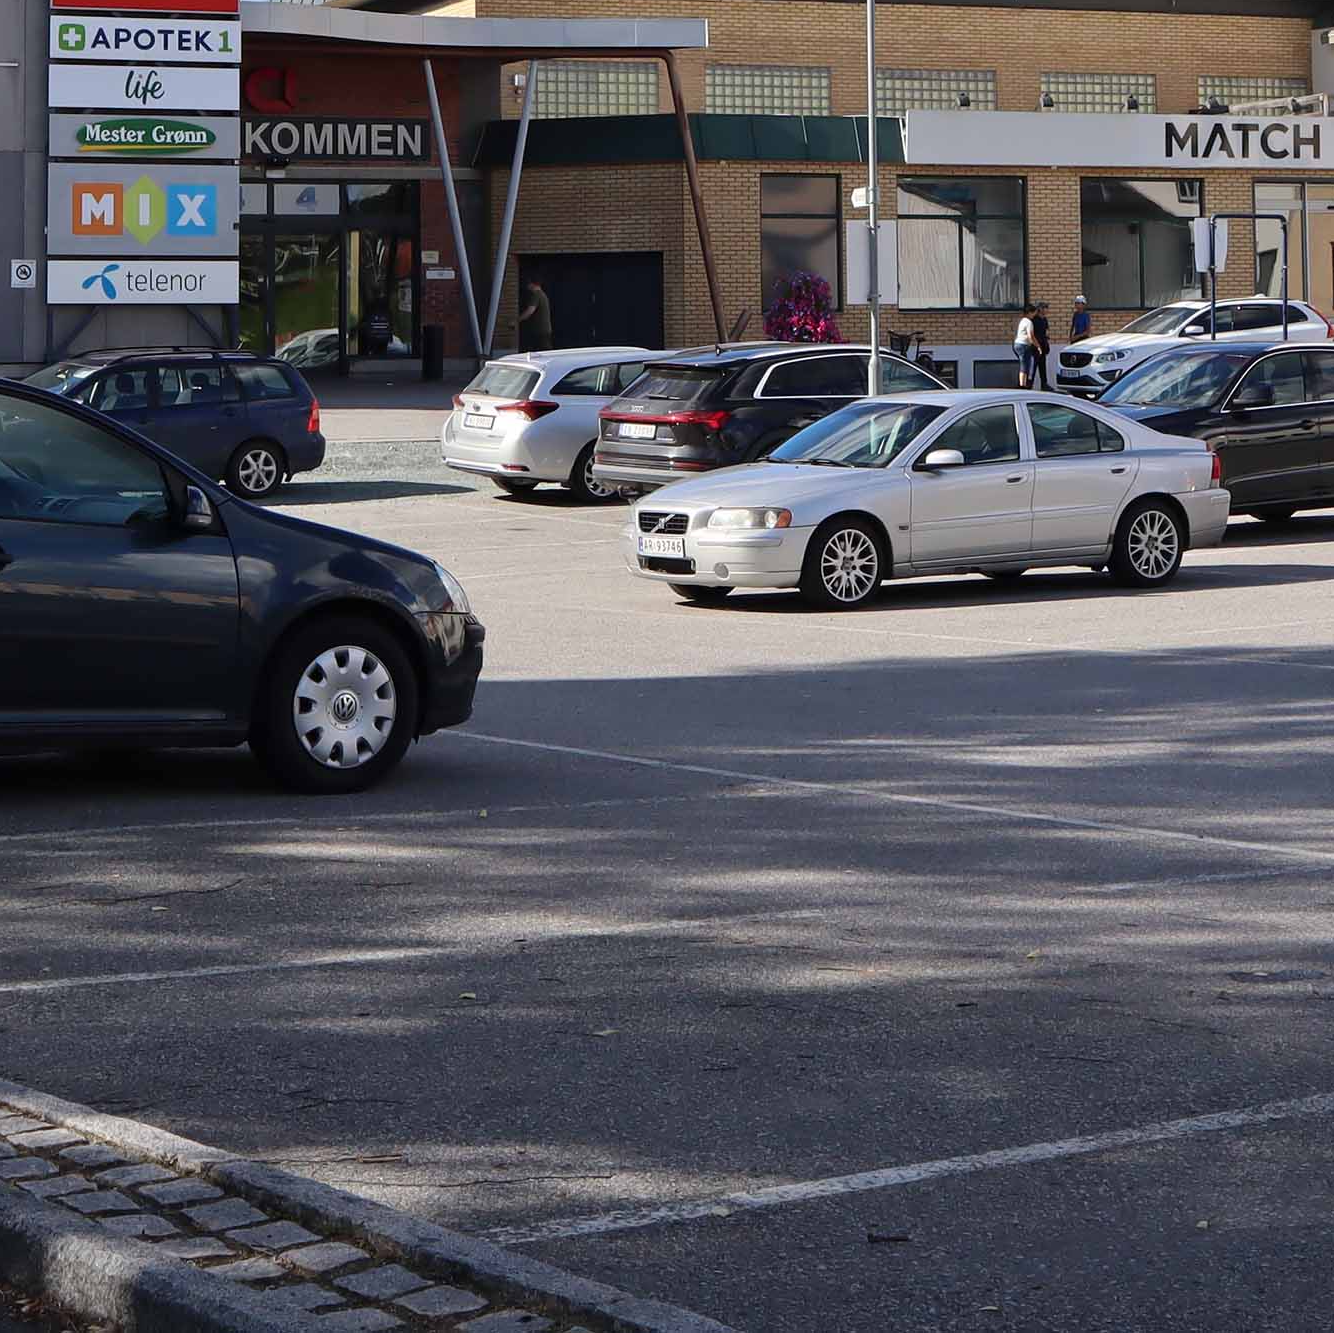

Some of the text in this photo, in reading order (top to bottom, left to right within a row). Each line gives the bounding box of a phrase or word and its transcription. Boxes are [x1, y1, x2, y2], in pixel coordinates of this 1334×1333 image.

[90, 27, 233, 53] APOTEK 1
[125, 70, 165, 105] life
[85, 124, 207, 144] Mester Grønn
[1165, 122, 1320, 160] MATCH
[81, 193, 206, 227] MIX
[126, 268, 206, 291] telenor
